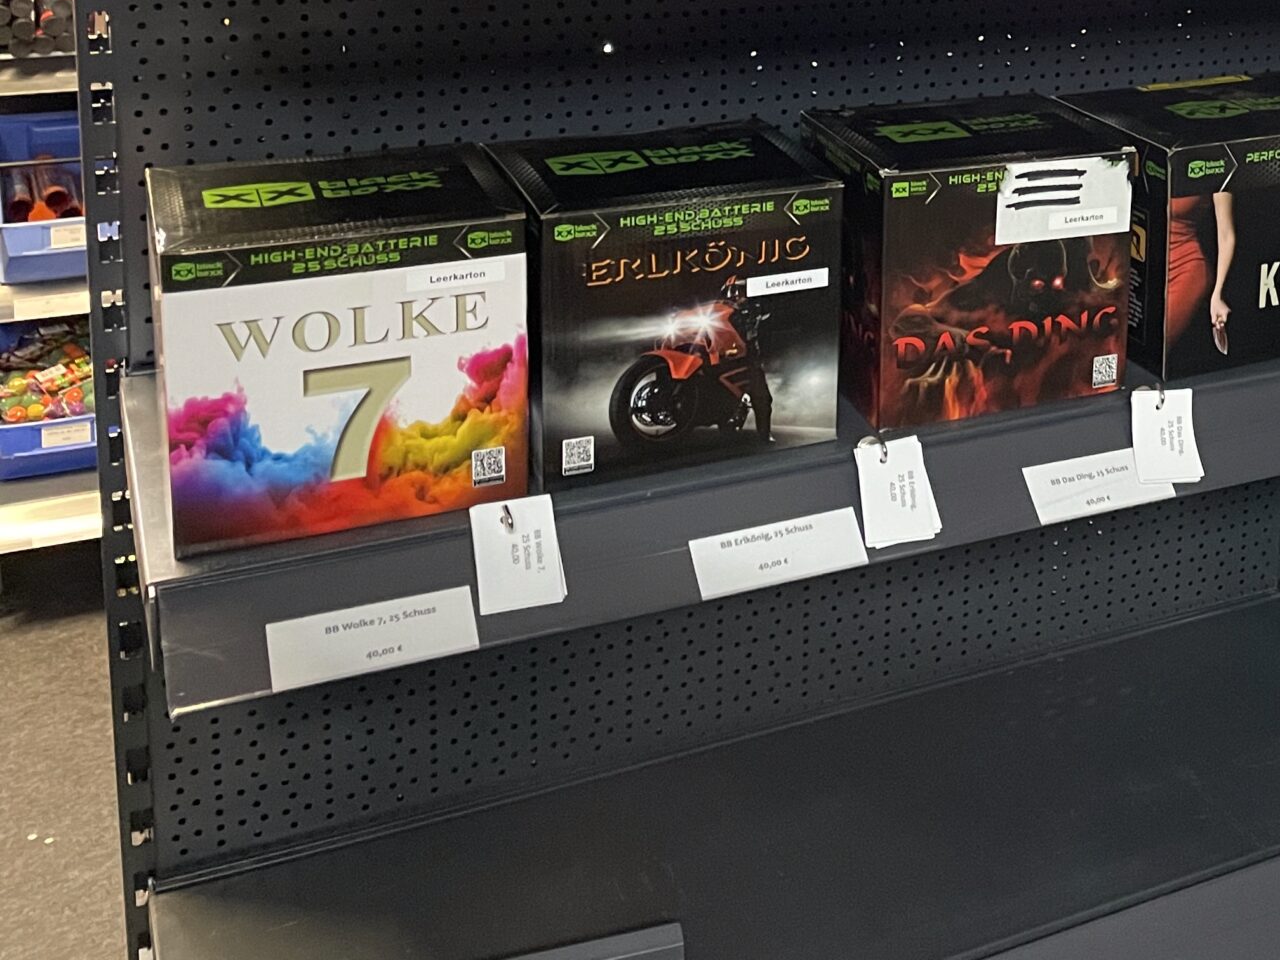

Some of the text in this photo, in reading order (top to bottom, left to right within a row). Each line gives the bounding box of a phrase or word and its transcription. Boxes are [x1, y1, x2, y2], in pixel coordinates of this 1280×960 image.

[317, 170, 437, 190] black
[949, 171, 1006, 187] HIGH-EN
[976, 182, 998, 194] 25
[620, 201, 775, 228] HIGH-END BATTERIE
[1064, 212, 1104, 225] Leerkarton
[653, 216, 744, 236] 25 SCHUSS
[251, 235, 438, 265] HIGH-END BATTERIE
[291, 252, 401, 273] 25 SCHUSS
[586, 236, 811, 287] ERLKÖNIG
[429, 269, 486, 285] Leerkarton
[765, 276, 813, 289] Leerkarton
[216, 291, 489, 362] WOLKE
[303, 355, 412, 482] 7
[1105, 465, 1129, 476] Schuss
[785, 522, 814, 537] Schuss
[325, 624, 340, 635] BB
[342, 618, 375, 632] Wolke
[402, 605, 437, 621] Schuss
[366, 646, 395, 660] 40,00
